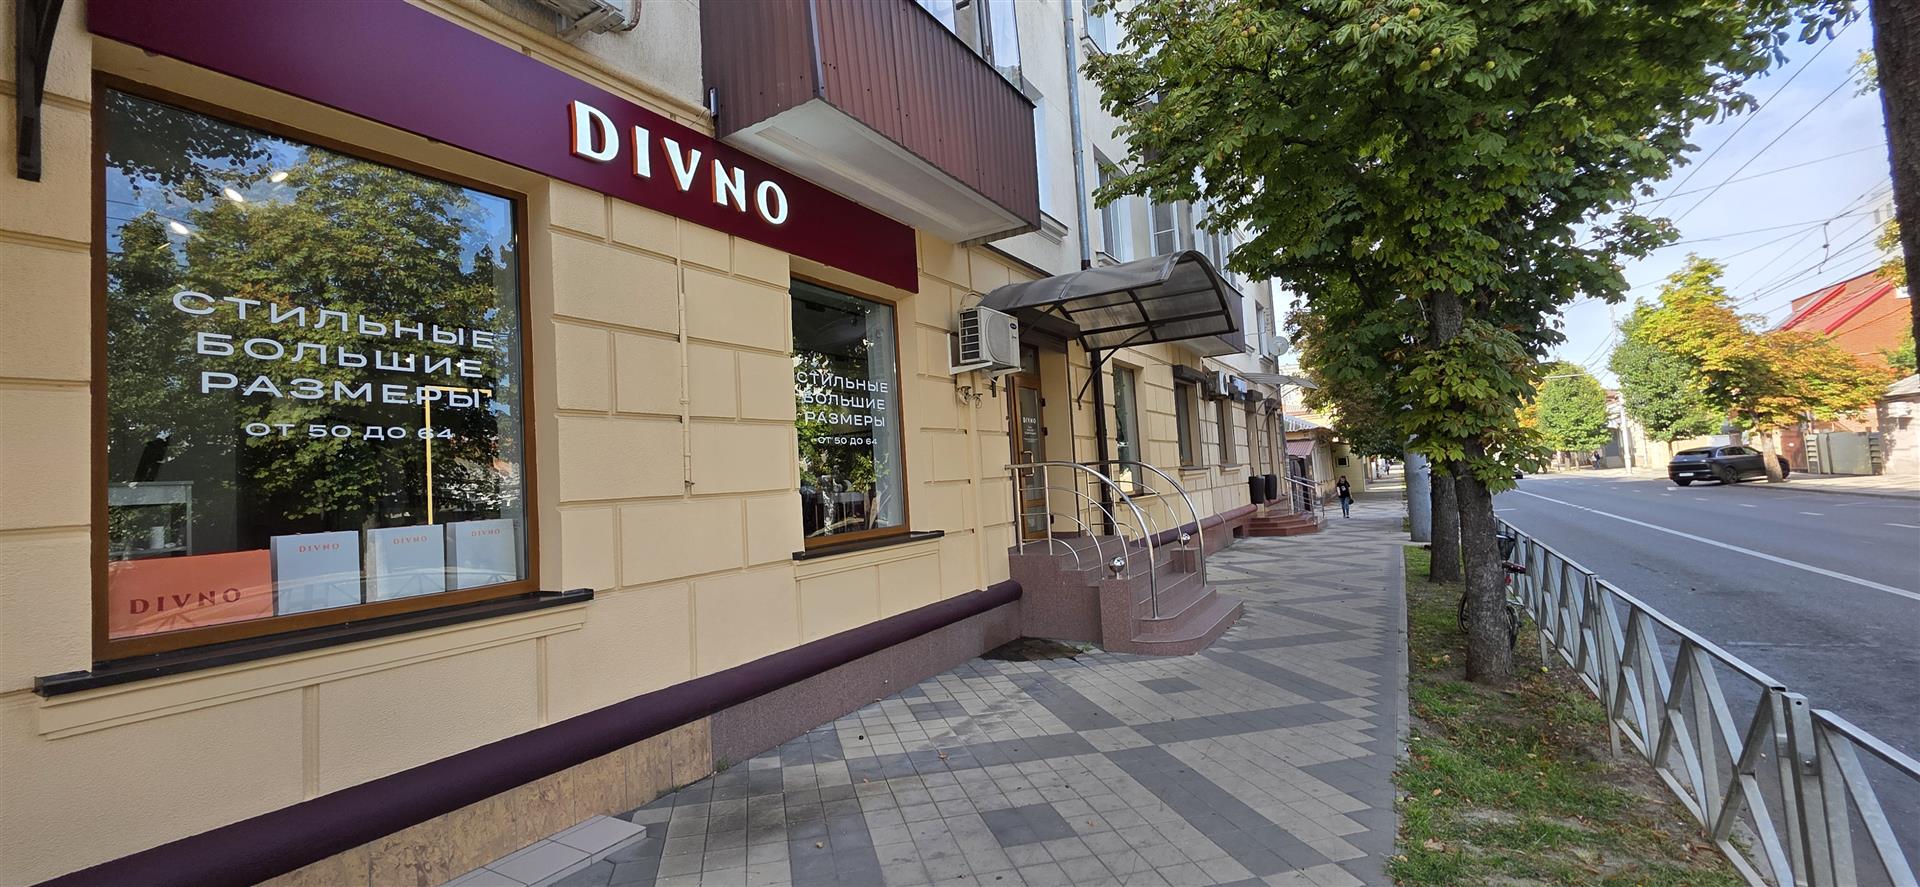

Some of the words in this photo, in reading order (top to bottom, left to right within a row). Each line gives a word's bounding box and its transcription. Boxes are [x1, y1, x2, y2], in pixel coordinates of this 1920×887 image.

[569, 100, 789, 225] DIVNO
[172, 290, 495, 350] СТИЛЬНЫЕ
[197, 332, 483, 378] БОЛЬШИЕ
[201, 371, 481, 408] РАЗМЕРЫ
[796, 371, 889, 393] СТИЛЬНЫЕ
[803, 392, 886, 410] БОЛЬШИЕ
[804, 411, 885, 427] РАЗМЕРЫ
[245, 422, 296, 437] ОТ
[308, 424, 352, 439] 50
[362, 425, 407, 441] ДО
[417, 427, 453, 440] 64
[817, 436, 832, 444] ОТ
[834, 437, 847, 445] 50
[849, 437, 864, 446] ДО
[865, 437, 878, 445] 64
[393, 535, 428, 545] DIVNO
[470, 527, 502, 537] DIVNO
[298, 543, 340, 553] DIVNO
[129, 587, 242, 615] DIVNO
